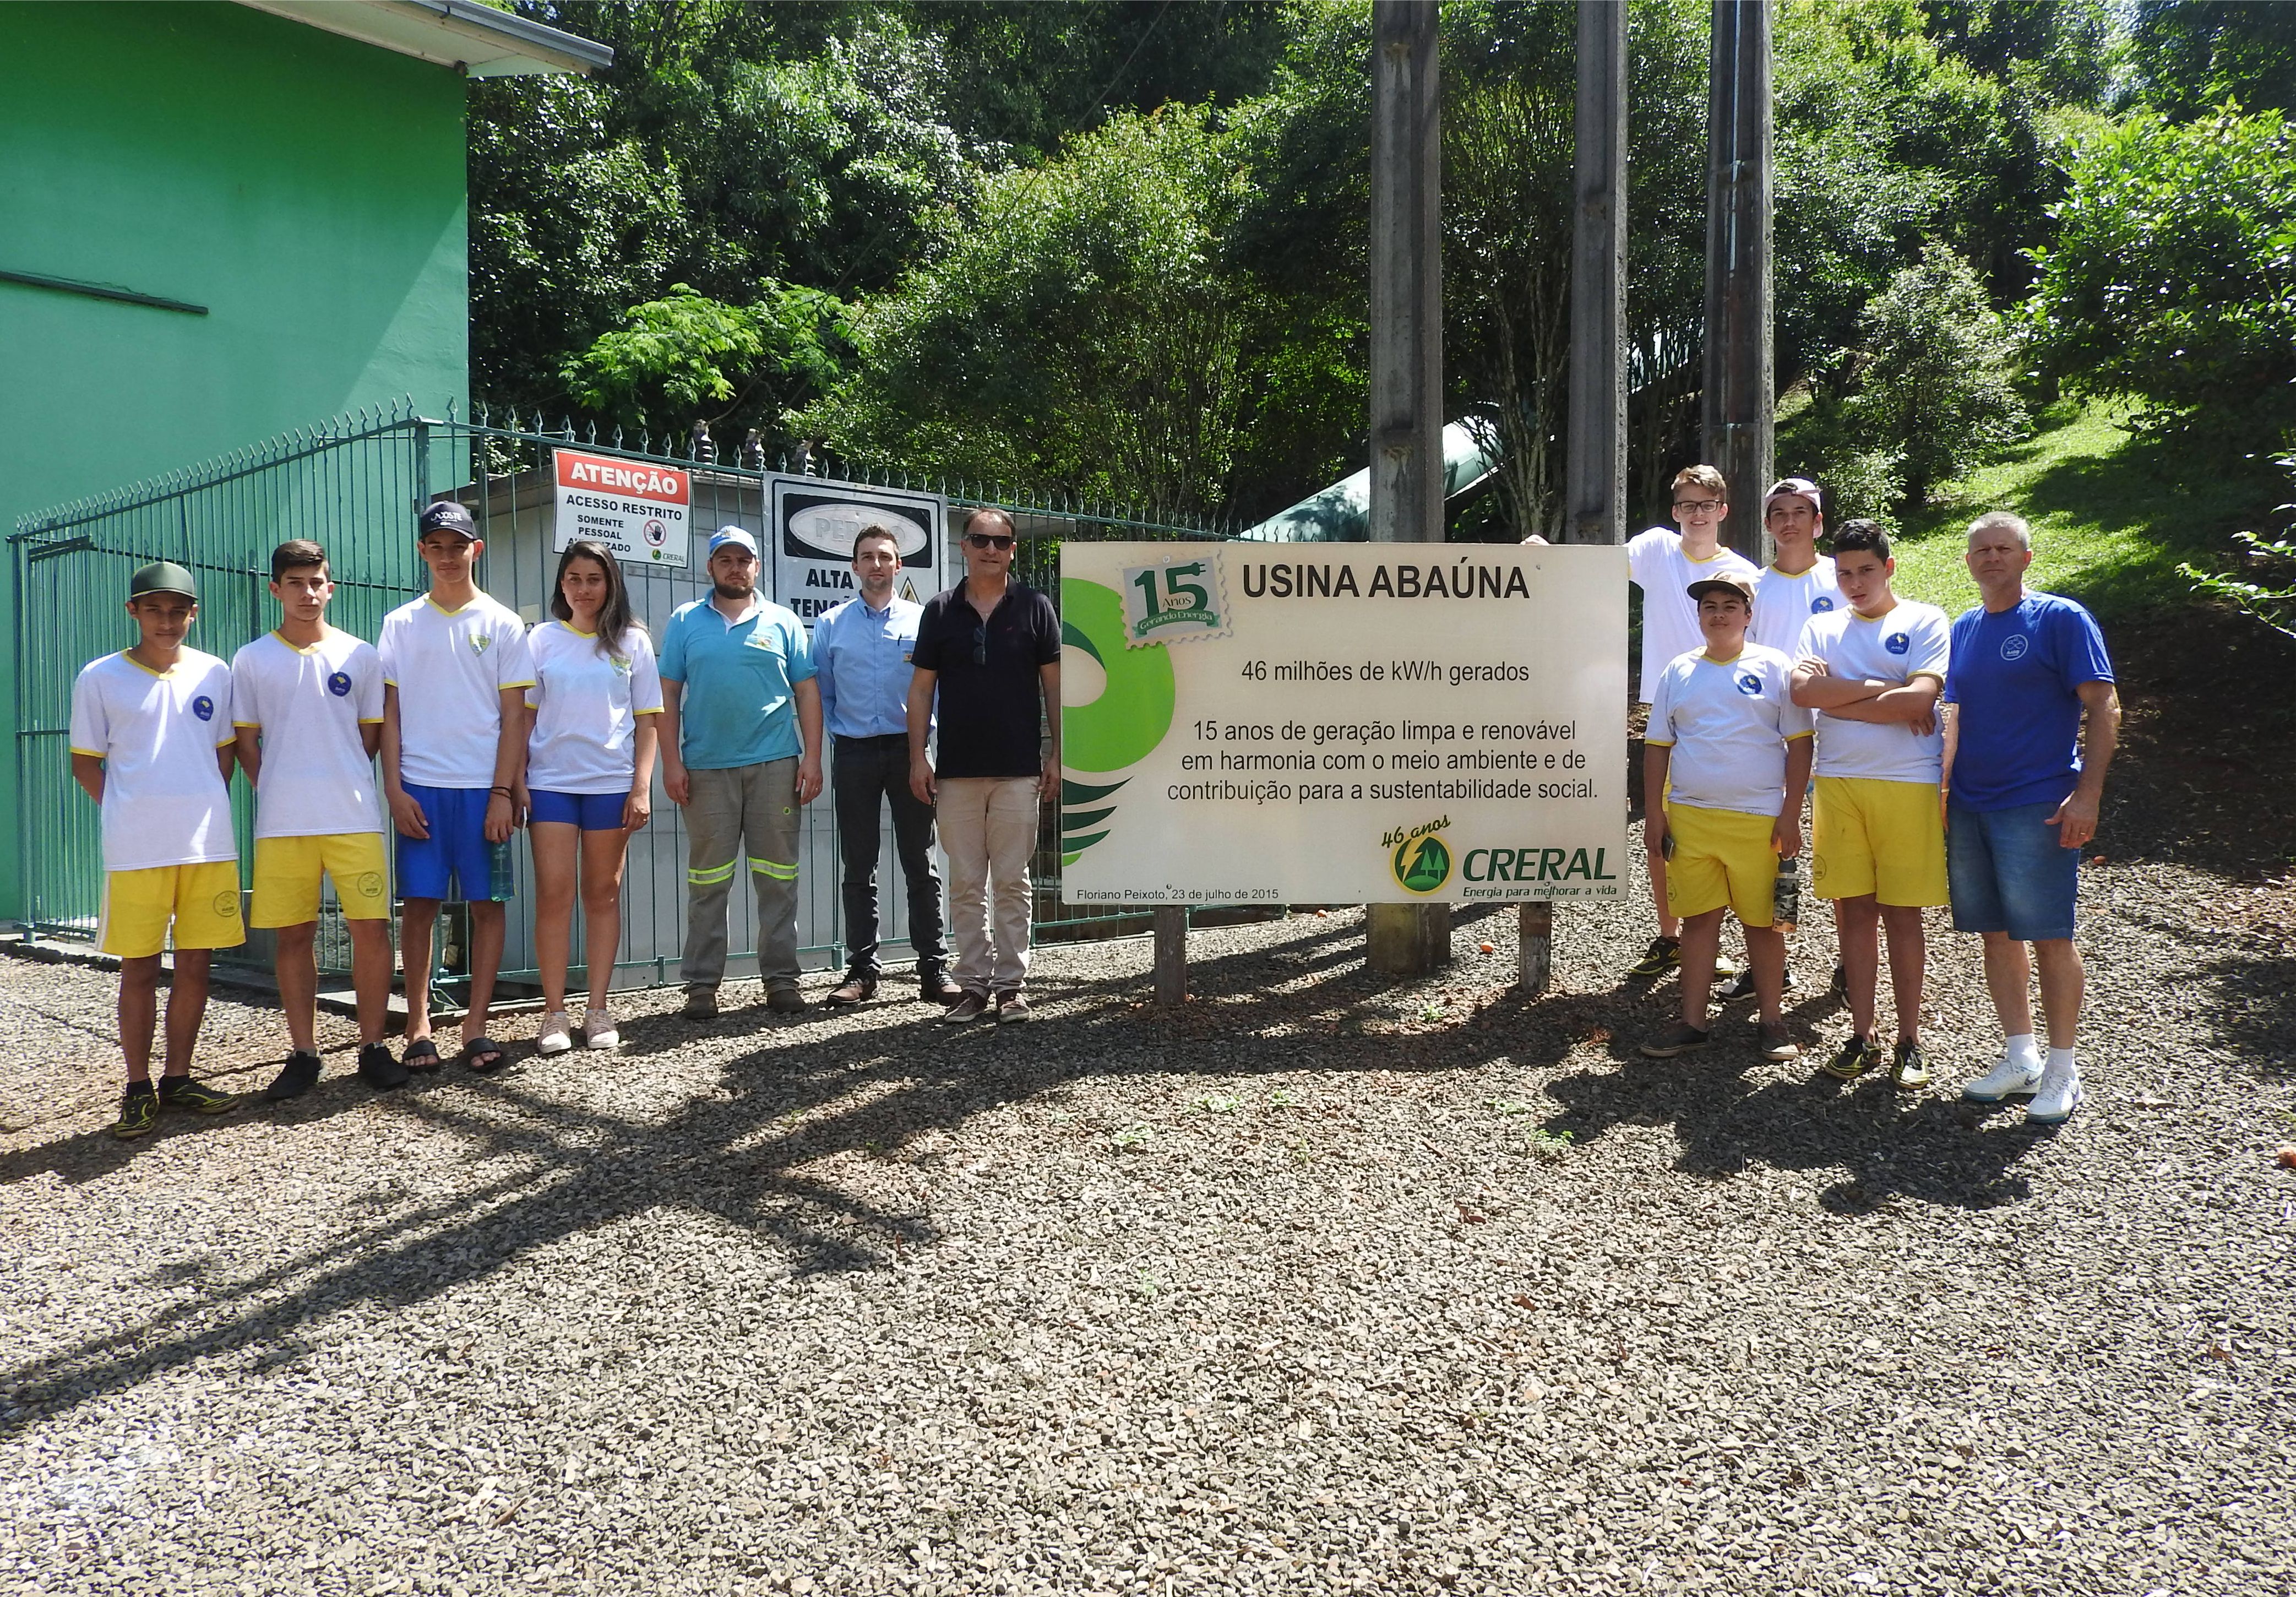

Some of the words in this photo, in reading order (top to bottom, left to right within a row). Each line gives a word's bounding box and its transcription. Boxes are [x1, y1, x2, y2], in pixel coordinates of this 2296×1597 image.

[571, 461, 678, 495] ATENÇÃO
[567, 495, 618, 511] ACESSO
[622, 502, 682, 520] RESTRITO
[577, 514, 624, 528] SOMENTE
[578, 526, 622, 540] PESSOAL
[568, 537, 631, 552] AZADO
[663, 553, 684, 562] CRERAL
[806, 568, 854, 589] ALTA
[1244, 564, 1359, 597] USINA
[1368, 557, 1530, 598] ABAÚNA
[1135, 562, 1208, 618] 15
[1163, 596, 1191, 607] Anos
[1140, 613, 1177, 629] Gerando
[1178, 611, 1212, 621] Energia
[1242, 661, 1266, 680] 46
[1275, 661, 1352, 680] milhões
[1360, 661, 1384, 680] de
[1392, 661, 1441, 680] kW/h
[1450, 661, 1528, 686] gerados
[1195, 721, 1217, 740] 15
[1225, 726, 1274, 740] anos
[1282, 720, 1305, 740] de
[1314, 721, 1395, 745] geração
[1403, 720, 1455, 745] limpa
[1463, 725, 1473, 740] e
[1482, 720, 1575, 740] renovável
[1182, 756, 1212, 770] em
[1221, 750, 1315, 769] harmonia
[1324, 755, 1364, 769] com
[1373, 755, 1384, 769] o
[1392, 750, 1439, 769] meio
[1448, 749, 1537, 769] ambiente
[1544, 754, 1555, 769] e
[1563, 749, 1585, 768] de
[1168, 780, 1291, 805] contribuição
[1299, 785, 1343, 804] para
[1351, 785, 1362, 799] a
[1370, 779, 1531, 798] sustentabilidade
[1538, 779, 1597, 798] social.
[1381, 826, 1404, 848] 46
[1411, 815, 1451, 838] anos
[1463, 848, 1616, 881] CRERAL
[1077, 889, 1120, 899] Floriano
[1125, 889, 1168, 900] Peixoto,
[1172, 889, 1185, 899] 23
[1189, 889, 1201, 899] de
[1205, 889, 1231, 901] julho
[1234, 889, 1248, 899] de
[1252, 889, 1278, 899] 2015
[1463, 887, 1502, 899] Energia
[1506, 889, 1530, 898] para
[1533, 887, 1580, 896] melhorar
[1596, 886, 1617, 895] vida
